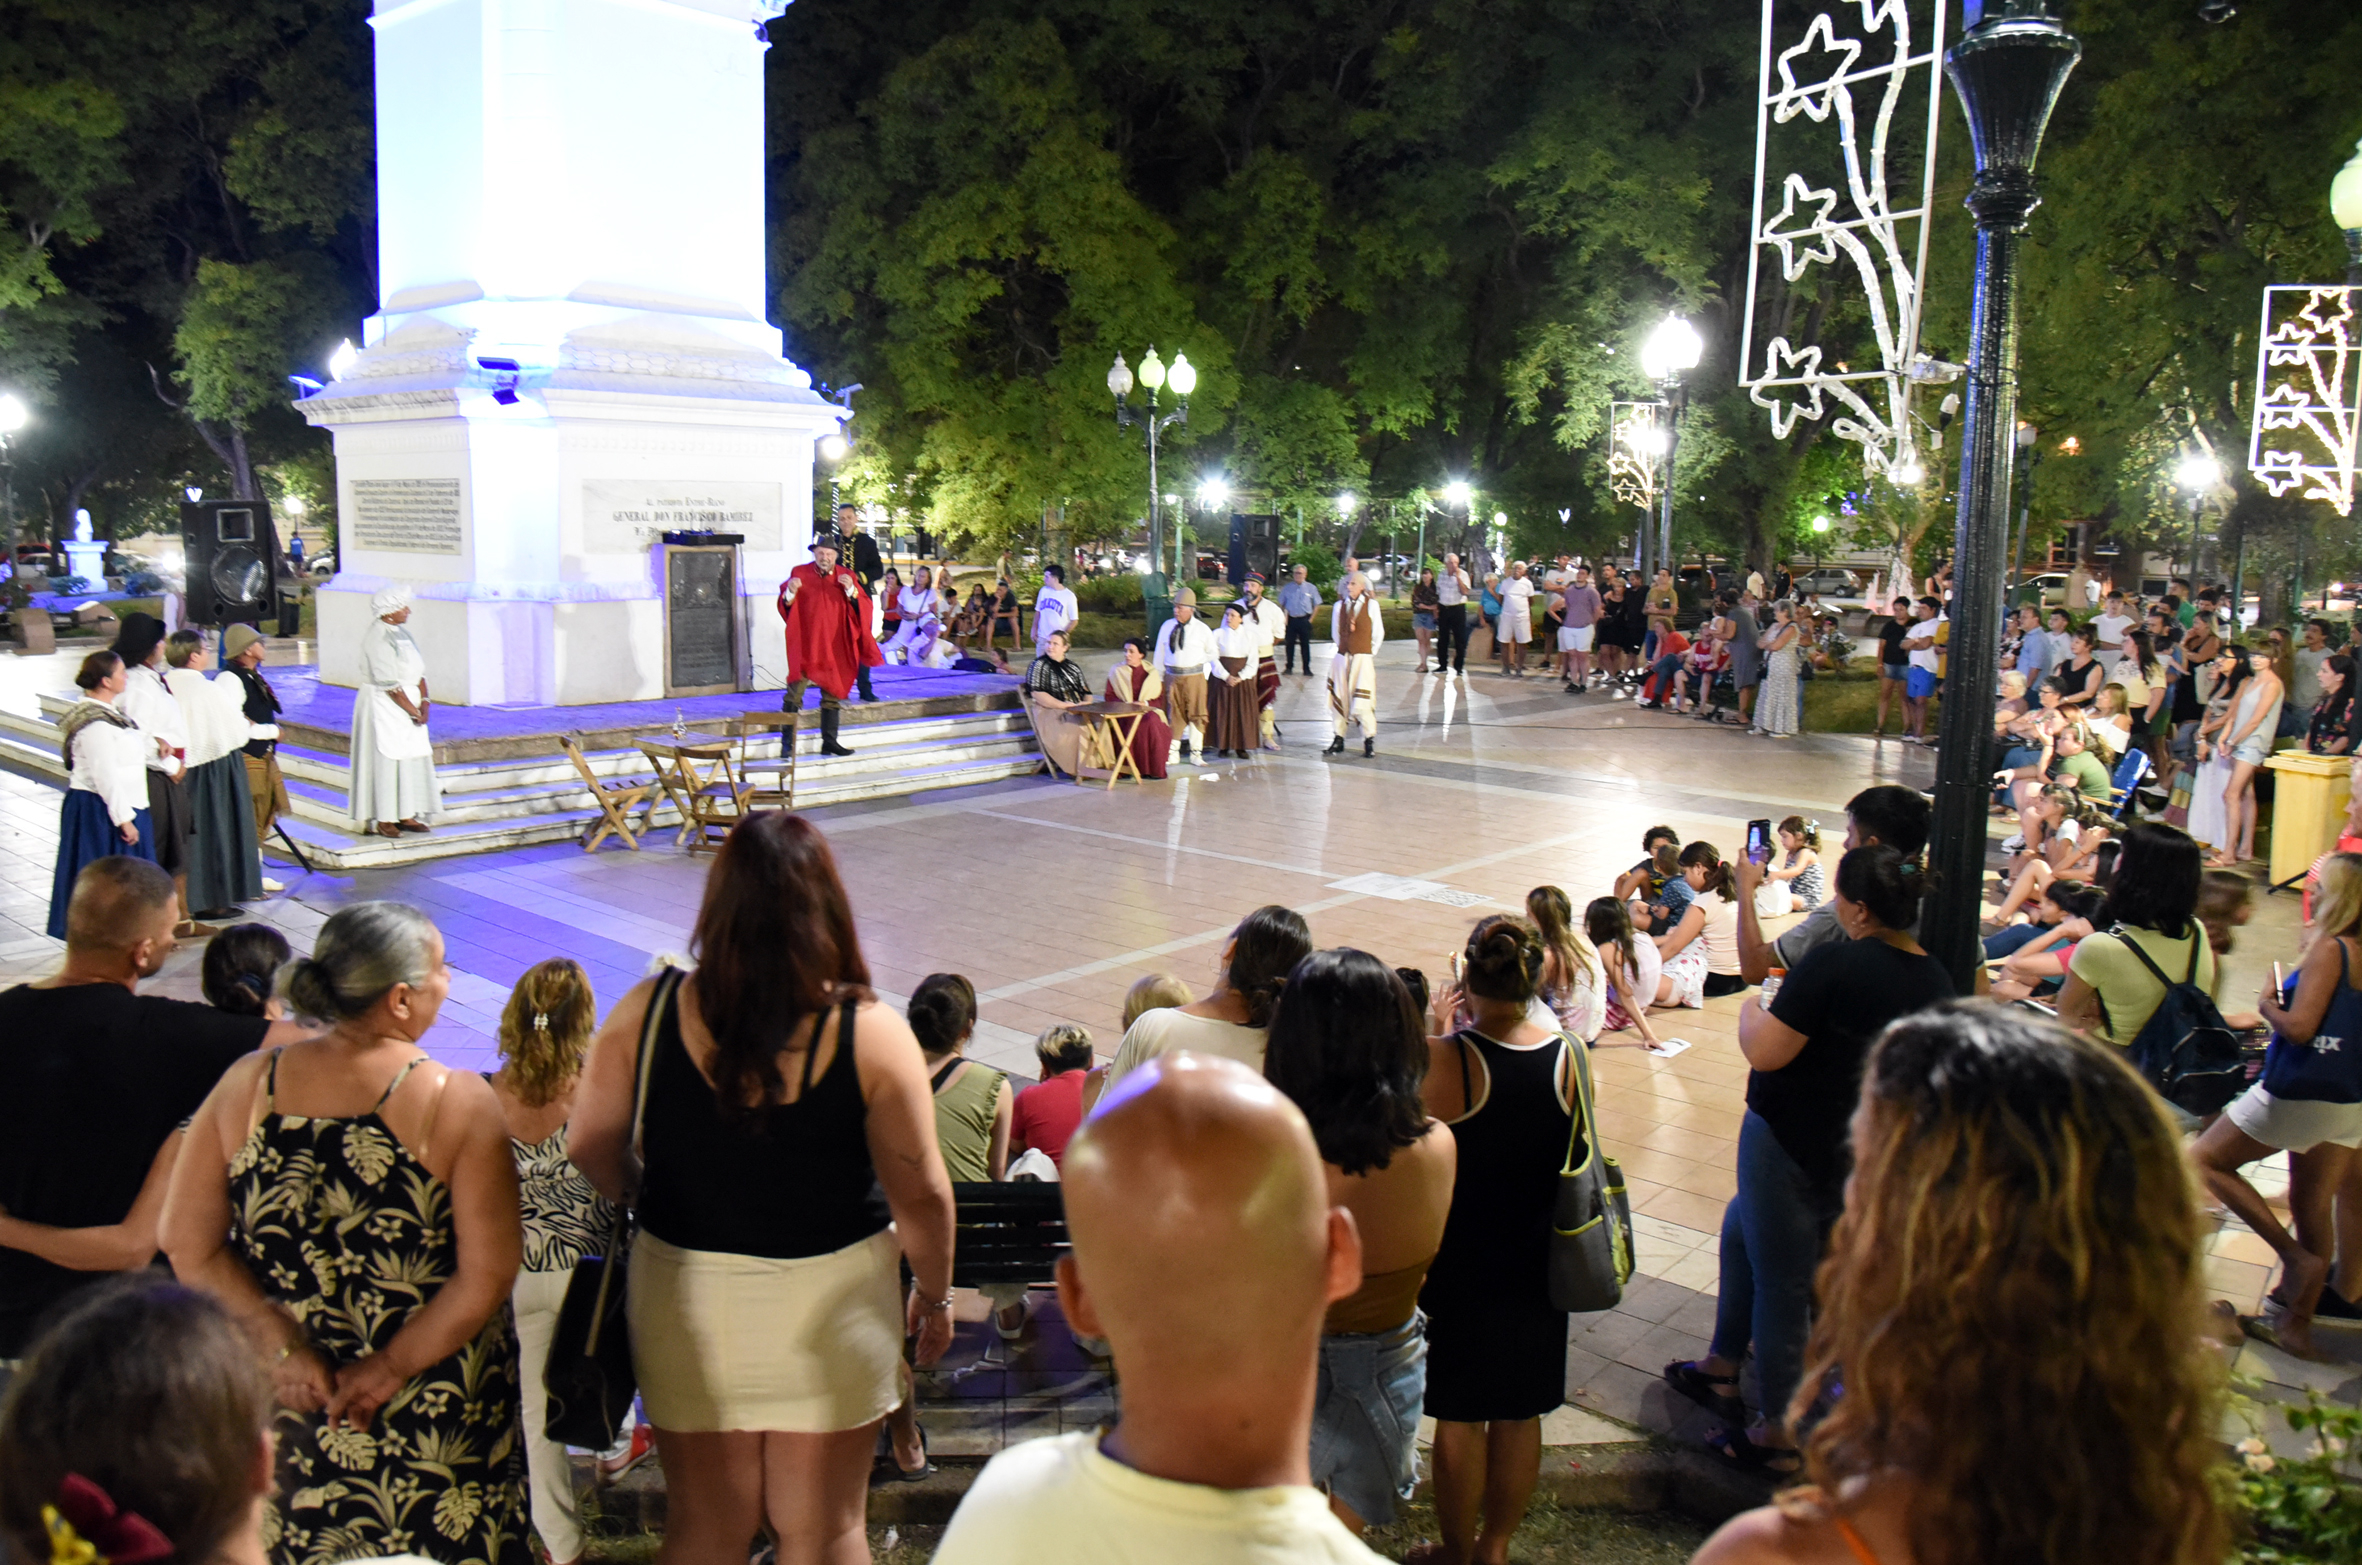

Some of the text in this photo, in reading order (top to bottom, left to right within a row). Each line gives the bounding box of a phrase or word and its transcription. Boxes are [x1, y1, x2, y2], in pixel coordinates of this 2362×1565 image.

[612, 511, 753, 523] GENERAL DON FRANCISCO RAMIREZ
